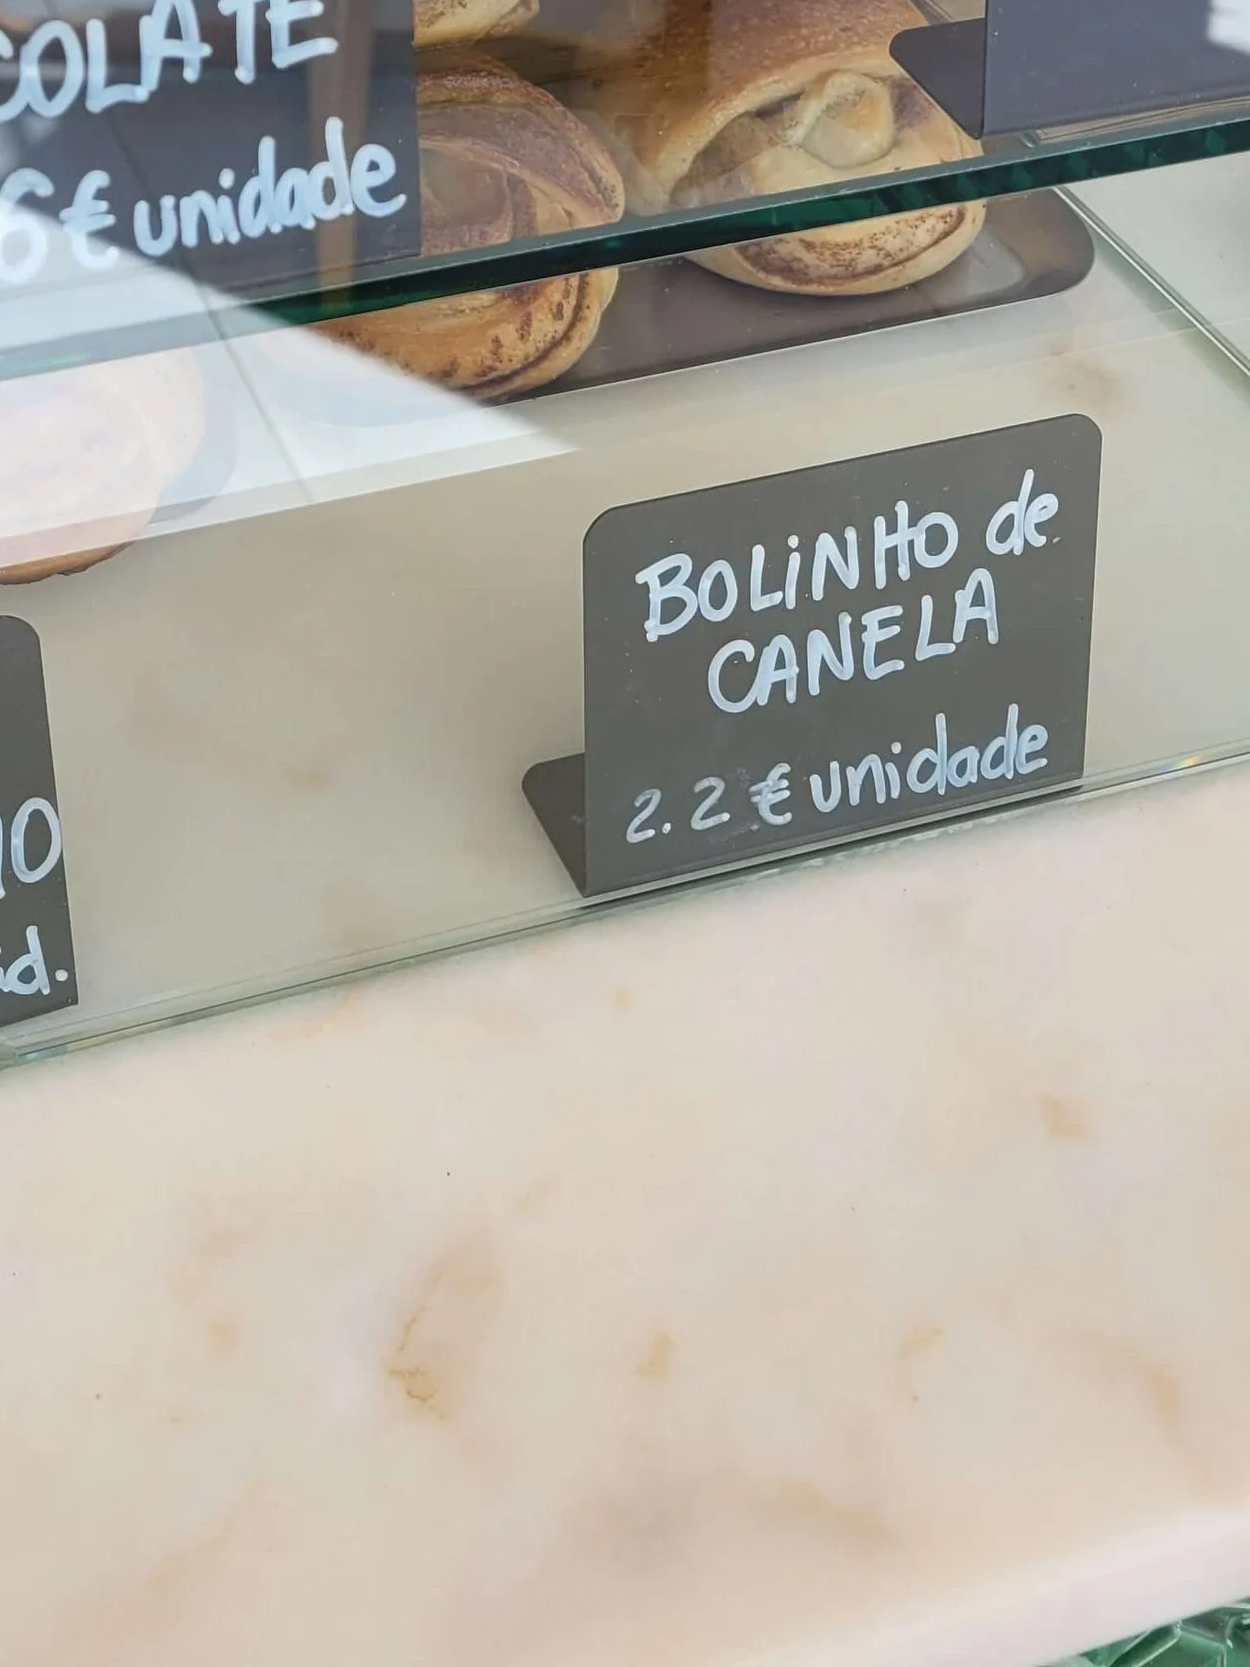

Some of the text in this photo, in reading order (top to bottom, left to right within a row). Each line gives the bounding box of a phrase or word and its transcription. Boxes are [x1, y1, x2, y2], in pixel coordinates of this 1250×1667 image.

[134, 116, 407, 259] unidade
[707, 569, 999, 713] CANELA
[809, 703, 1048, 813] unidade
